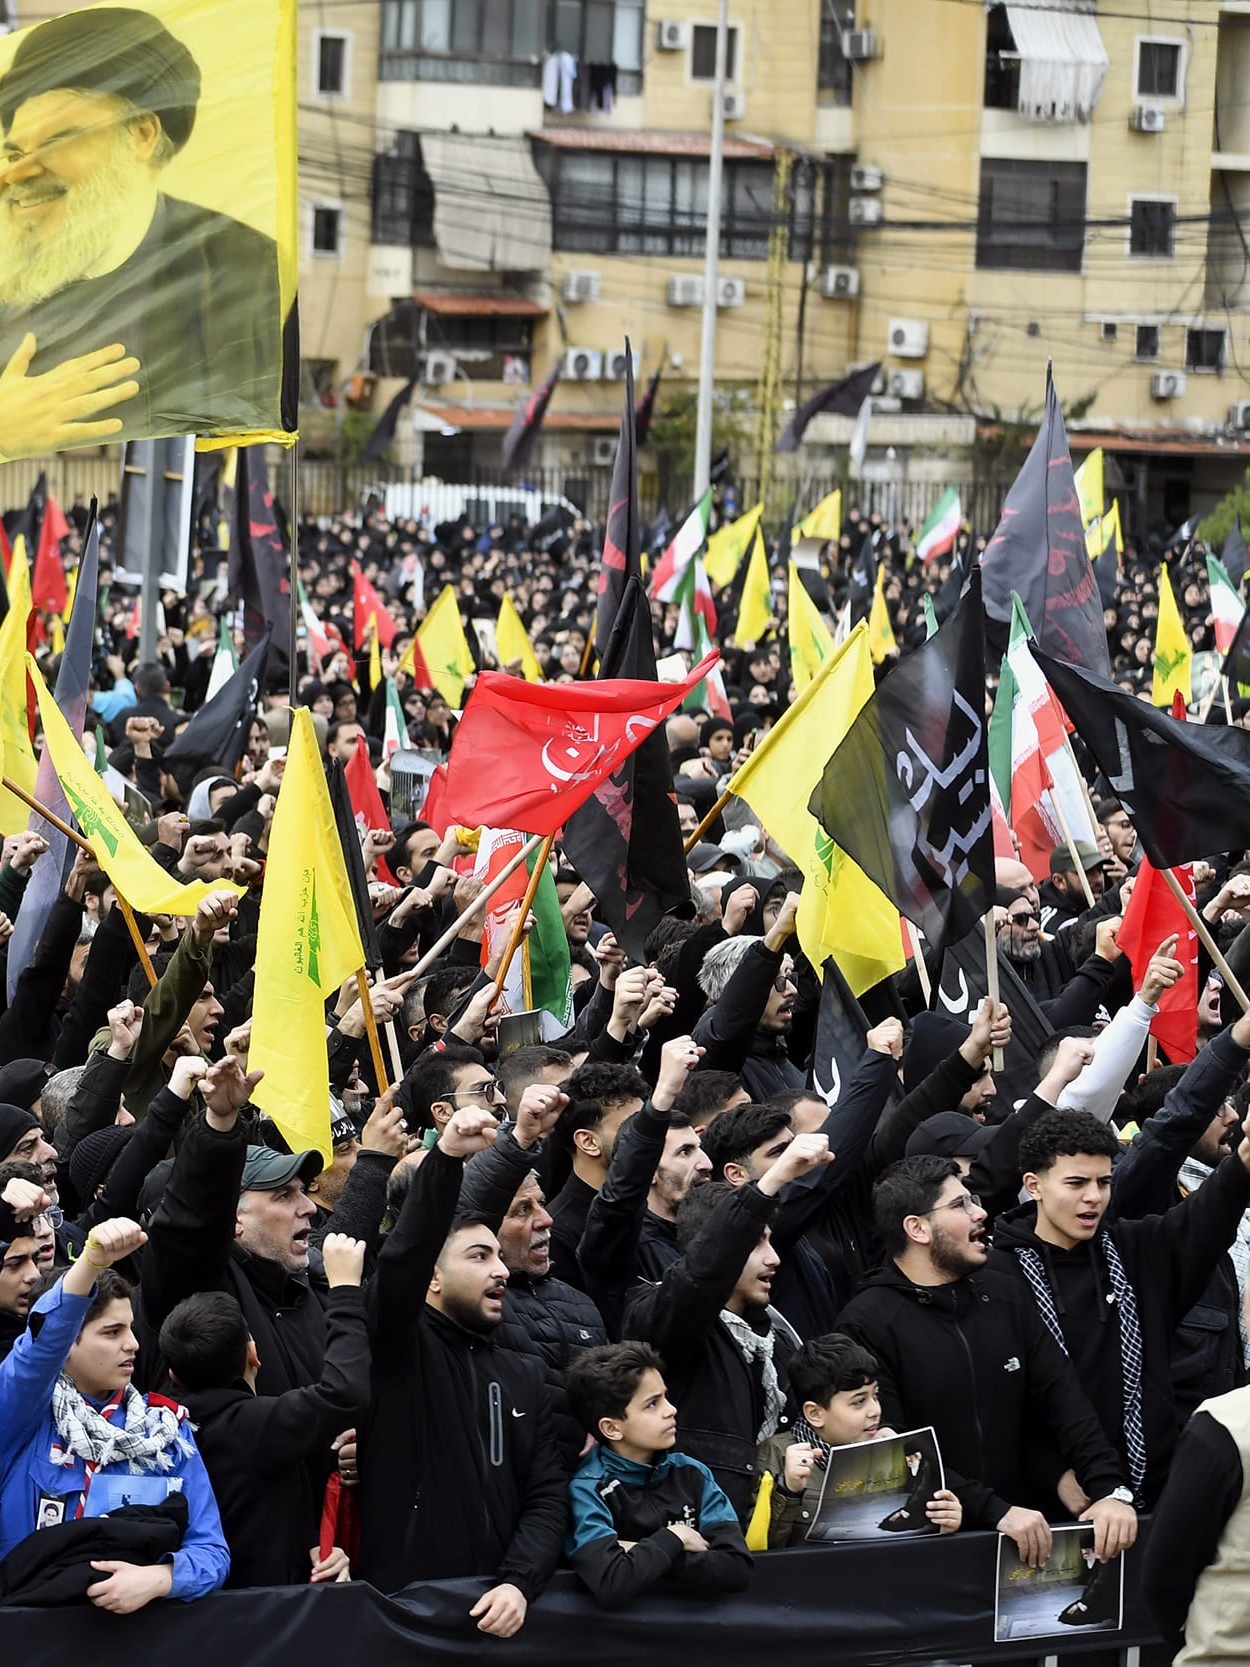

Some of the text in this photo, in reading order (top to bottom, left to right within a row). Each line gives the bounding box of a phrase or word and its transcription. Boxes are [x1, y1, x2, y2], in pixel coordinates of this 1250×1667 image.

[300, 886, 309, 908] حزب
[297, 911, 306, 924] الله
[294, 941, 304, 975] الغالبون
